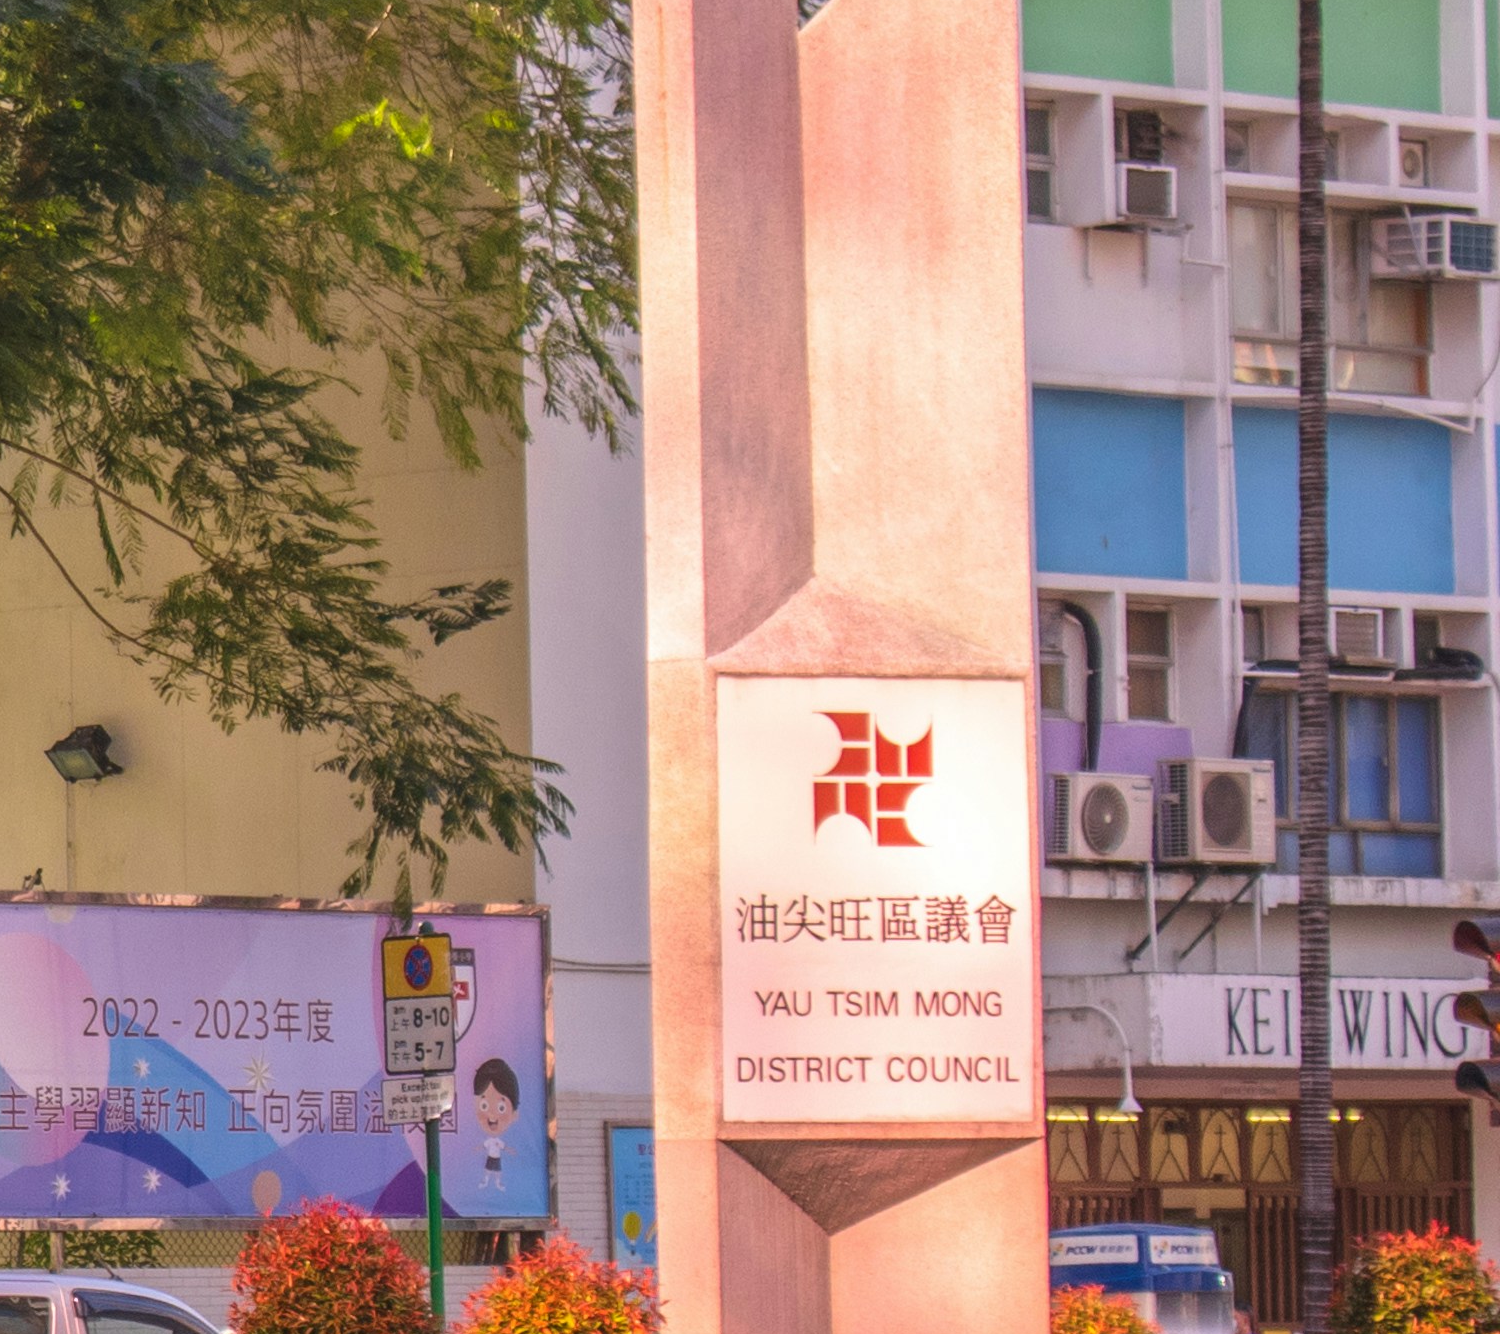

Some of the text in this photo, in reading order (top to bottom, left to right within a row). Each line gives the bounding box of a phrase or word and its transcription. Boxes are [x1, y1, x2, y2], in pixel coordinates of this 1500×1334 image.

[735, 893, 1018, 948] 油尖旺區議會
[413, 1007, 450, 1028] 8-10
[754, 988, 1003, 1018] YAU TSIM MONG
[82, 996, 161, 1039] 2022
[194, 998, 336, 1045] 2023年度
[1225, 987, 1469, 1059] KEI WING
[415, 1041, 445, 1062] 5-7
[736, 1056, 1020, 1085] DISTRICT COUNCIL
[1065, 1245, 1097, 1255] PCCW
